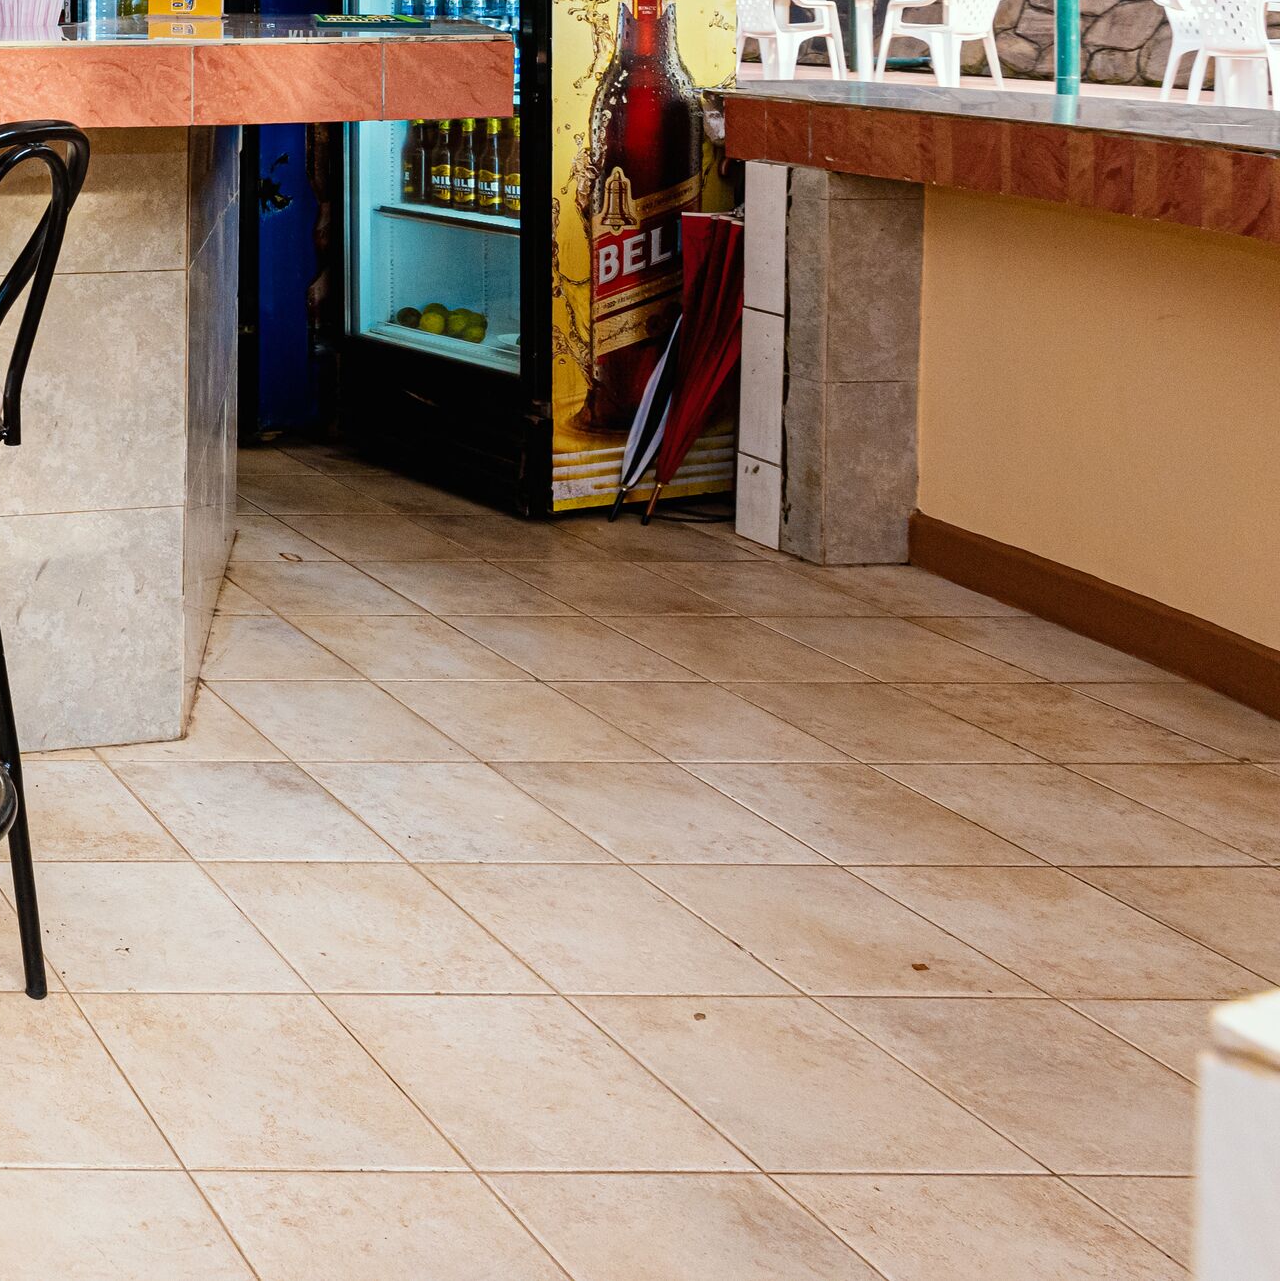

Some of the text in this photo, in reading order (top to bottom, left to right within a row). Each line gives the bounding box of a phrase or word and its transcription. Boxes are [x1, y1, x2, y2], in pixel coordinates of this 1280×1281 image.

[432, 175, 451, 185] NIL
[504, 185, 520, 195] NIL
[599, 219, 682, 286] BEL
